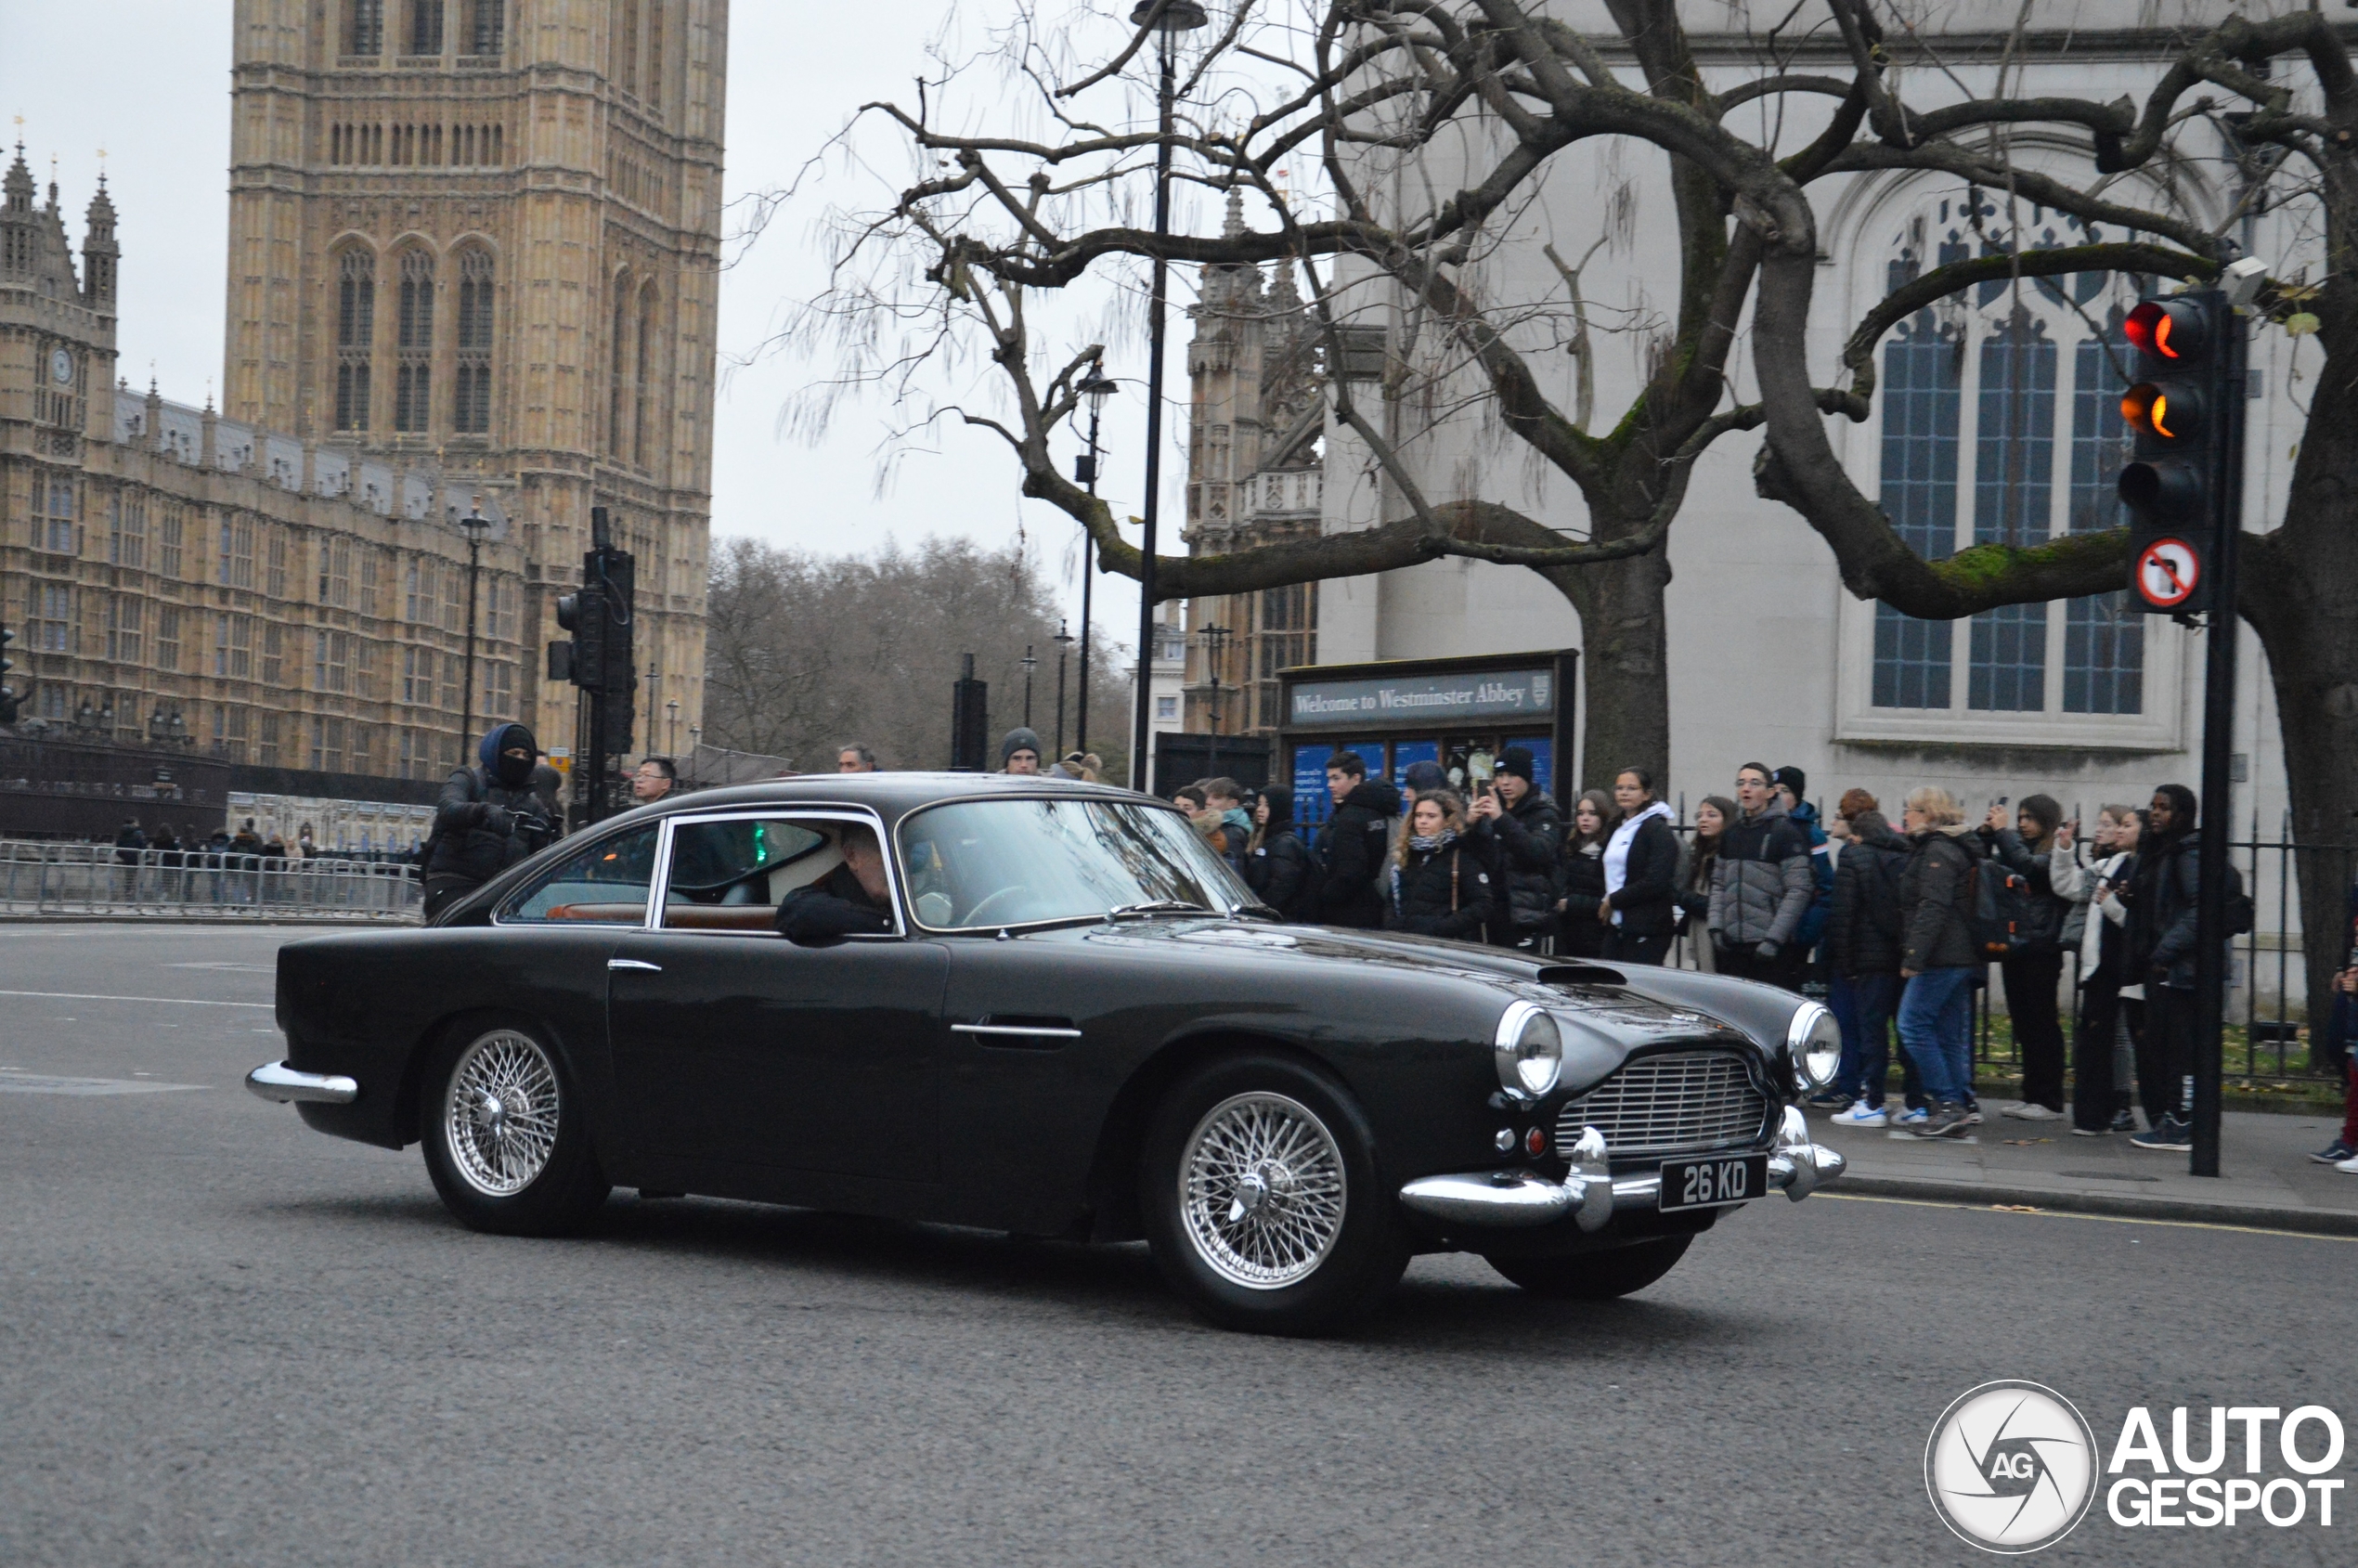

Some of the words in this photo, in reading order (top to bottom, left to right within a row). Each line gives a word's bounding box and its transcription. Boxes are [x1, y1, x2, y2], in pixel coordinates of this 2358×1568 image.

[1295, 694, 1359, 713] Welcome
[1361, 695, 1377, 710] to
[1379, 686, 1474, 708] Westminster
[1475, 682, 1526, 707] Abbey
[1683, 1165, 1714, 1204] 26
[1717, 1160, 1746, 1199] KD
